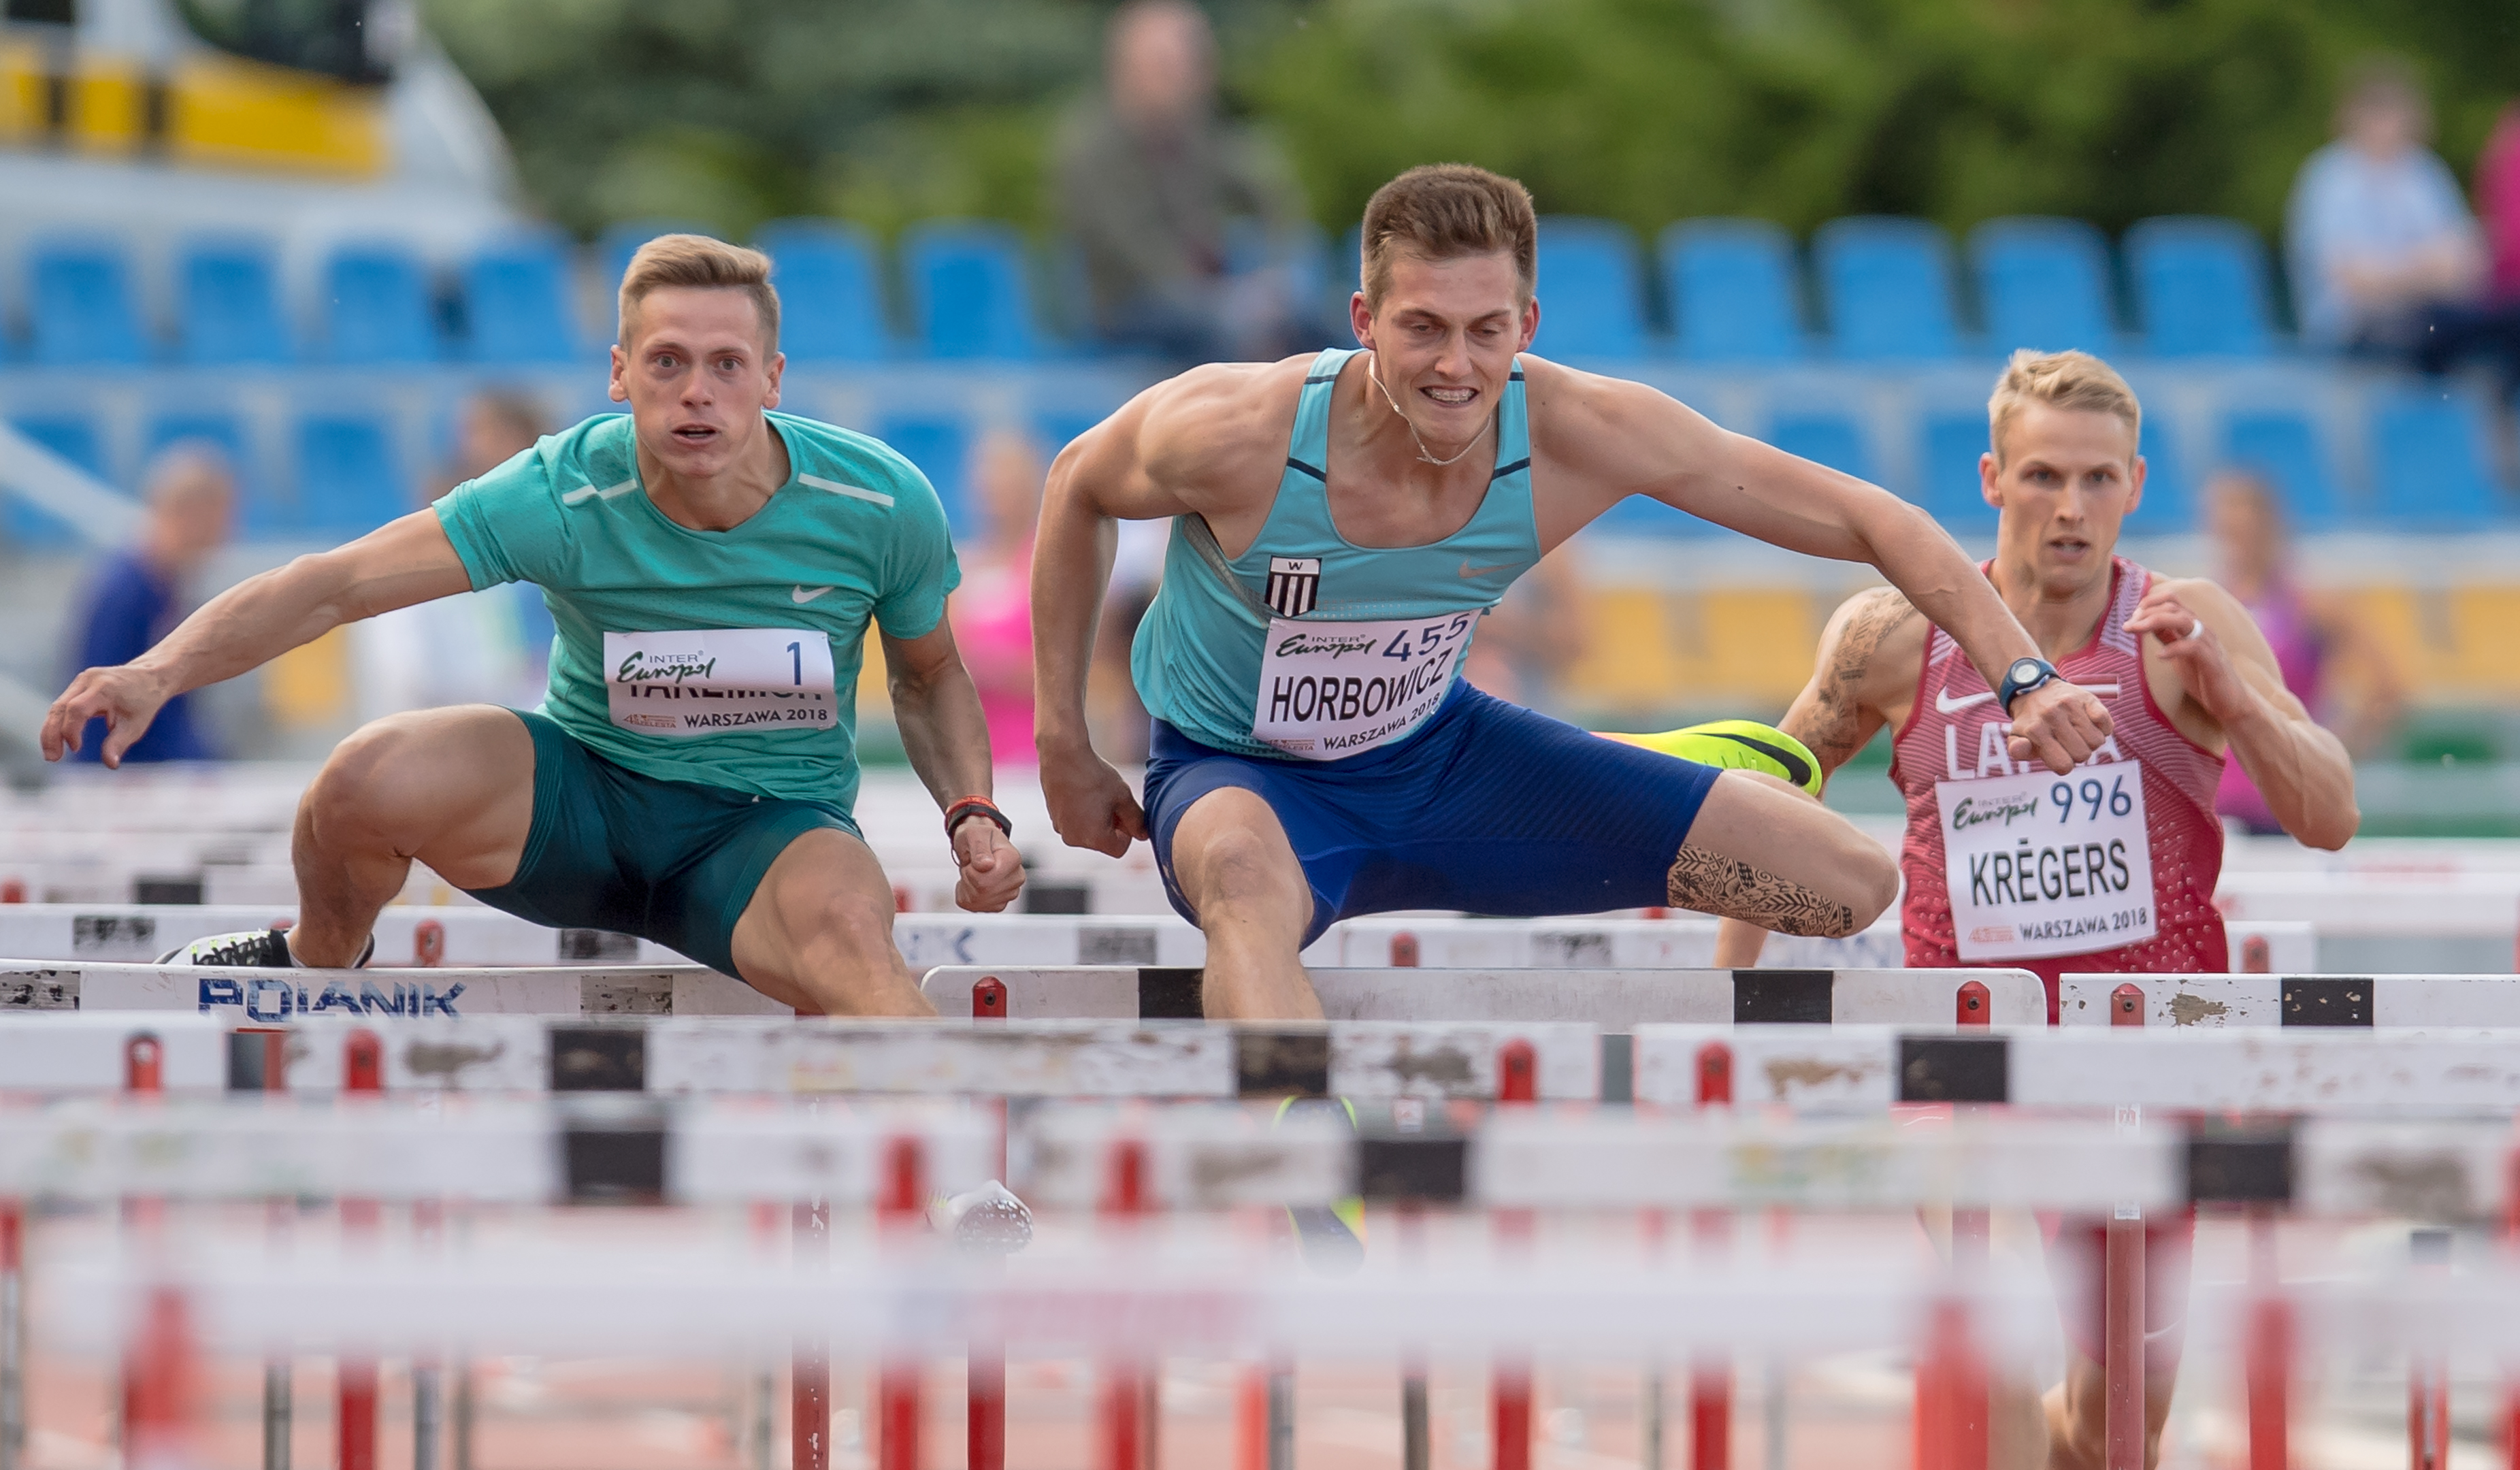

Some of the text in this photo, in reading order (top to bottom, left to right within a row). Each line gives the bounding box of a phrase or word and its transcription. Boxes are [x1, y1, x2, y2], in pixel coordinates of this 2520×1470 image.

[1288, 561, 1303, 570] W
[1275, 634, 1377, 659] Europol
[1382, 613, 1471, 662] 455
[617, 651, 716, 683] Europol
[649, 654, 698, 664] INTER
[787, 642, 802, 685] 1
[1269, 647, 1454, 723] HORBOWICZ
[684, 708, 781, 728] WARSZAWA
[786, 708, 828, 721] 2018
[1323, 691, 1441, 751] WARSZAWA 2018
[1952, 797, 2039, 830] Europol
[2050, 774, 2131, 823] 996
[1969, 837, 2129, 906] KRĒGERS
[2019, 916, 2108, 943] WARSZAWA
[2112, 907, 2148, 930] 2018
